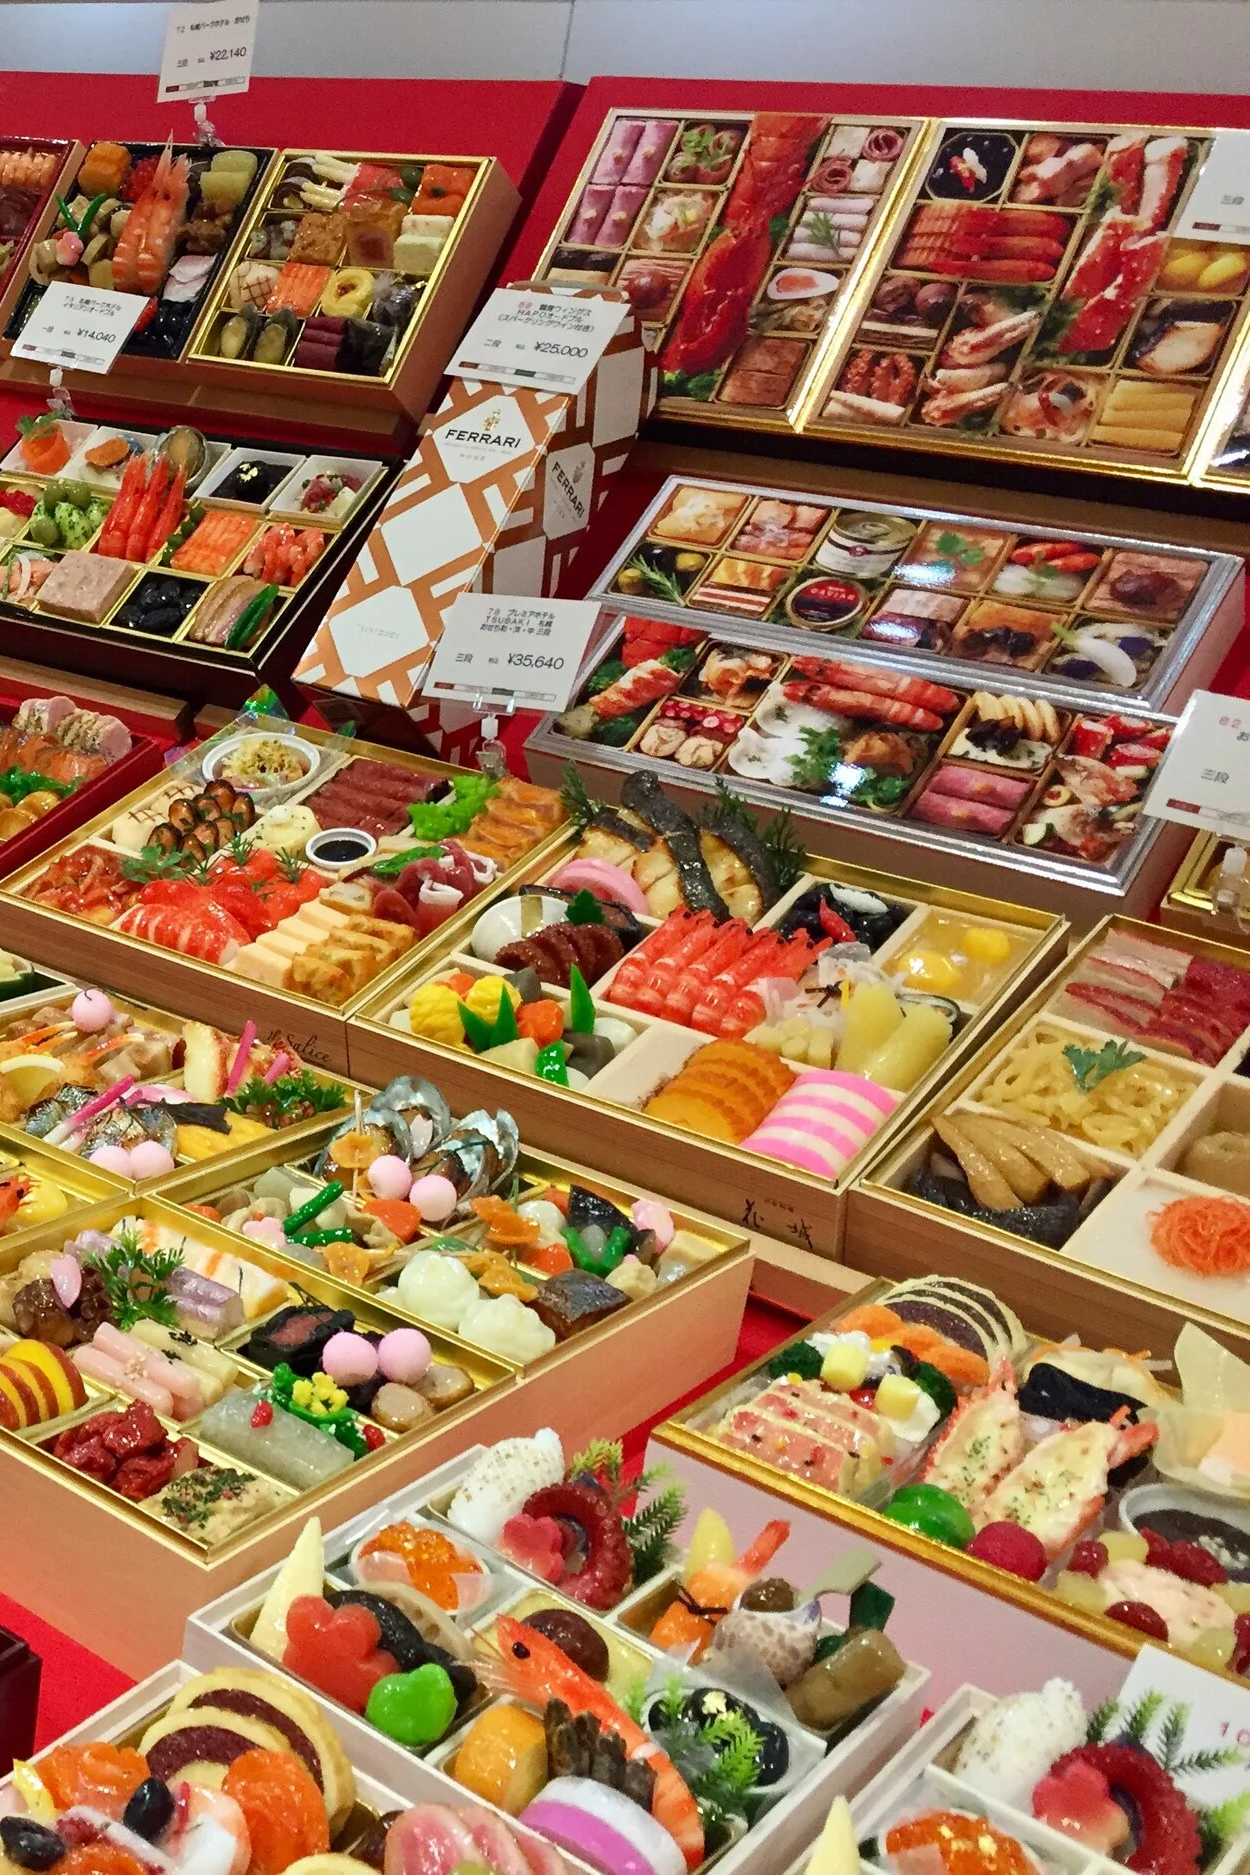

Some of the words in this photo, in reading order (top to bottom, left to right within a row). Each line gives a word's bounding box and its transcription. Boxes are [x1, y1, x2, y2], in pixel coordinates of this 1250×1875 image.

[210, 46, 247, 61] ¥22,140
[76, 328, 117, 344] ¥14,040
[533, 341, 589, 358] ¥25,000
[444, 428, 522, 449] FERRARI
[551, 461, 586, 519] FERRARI
[507, 652, 566, 670] ¥35,640
